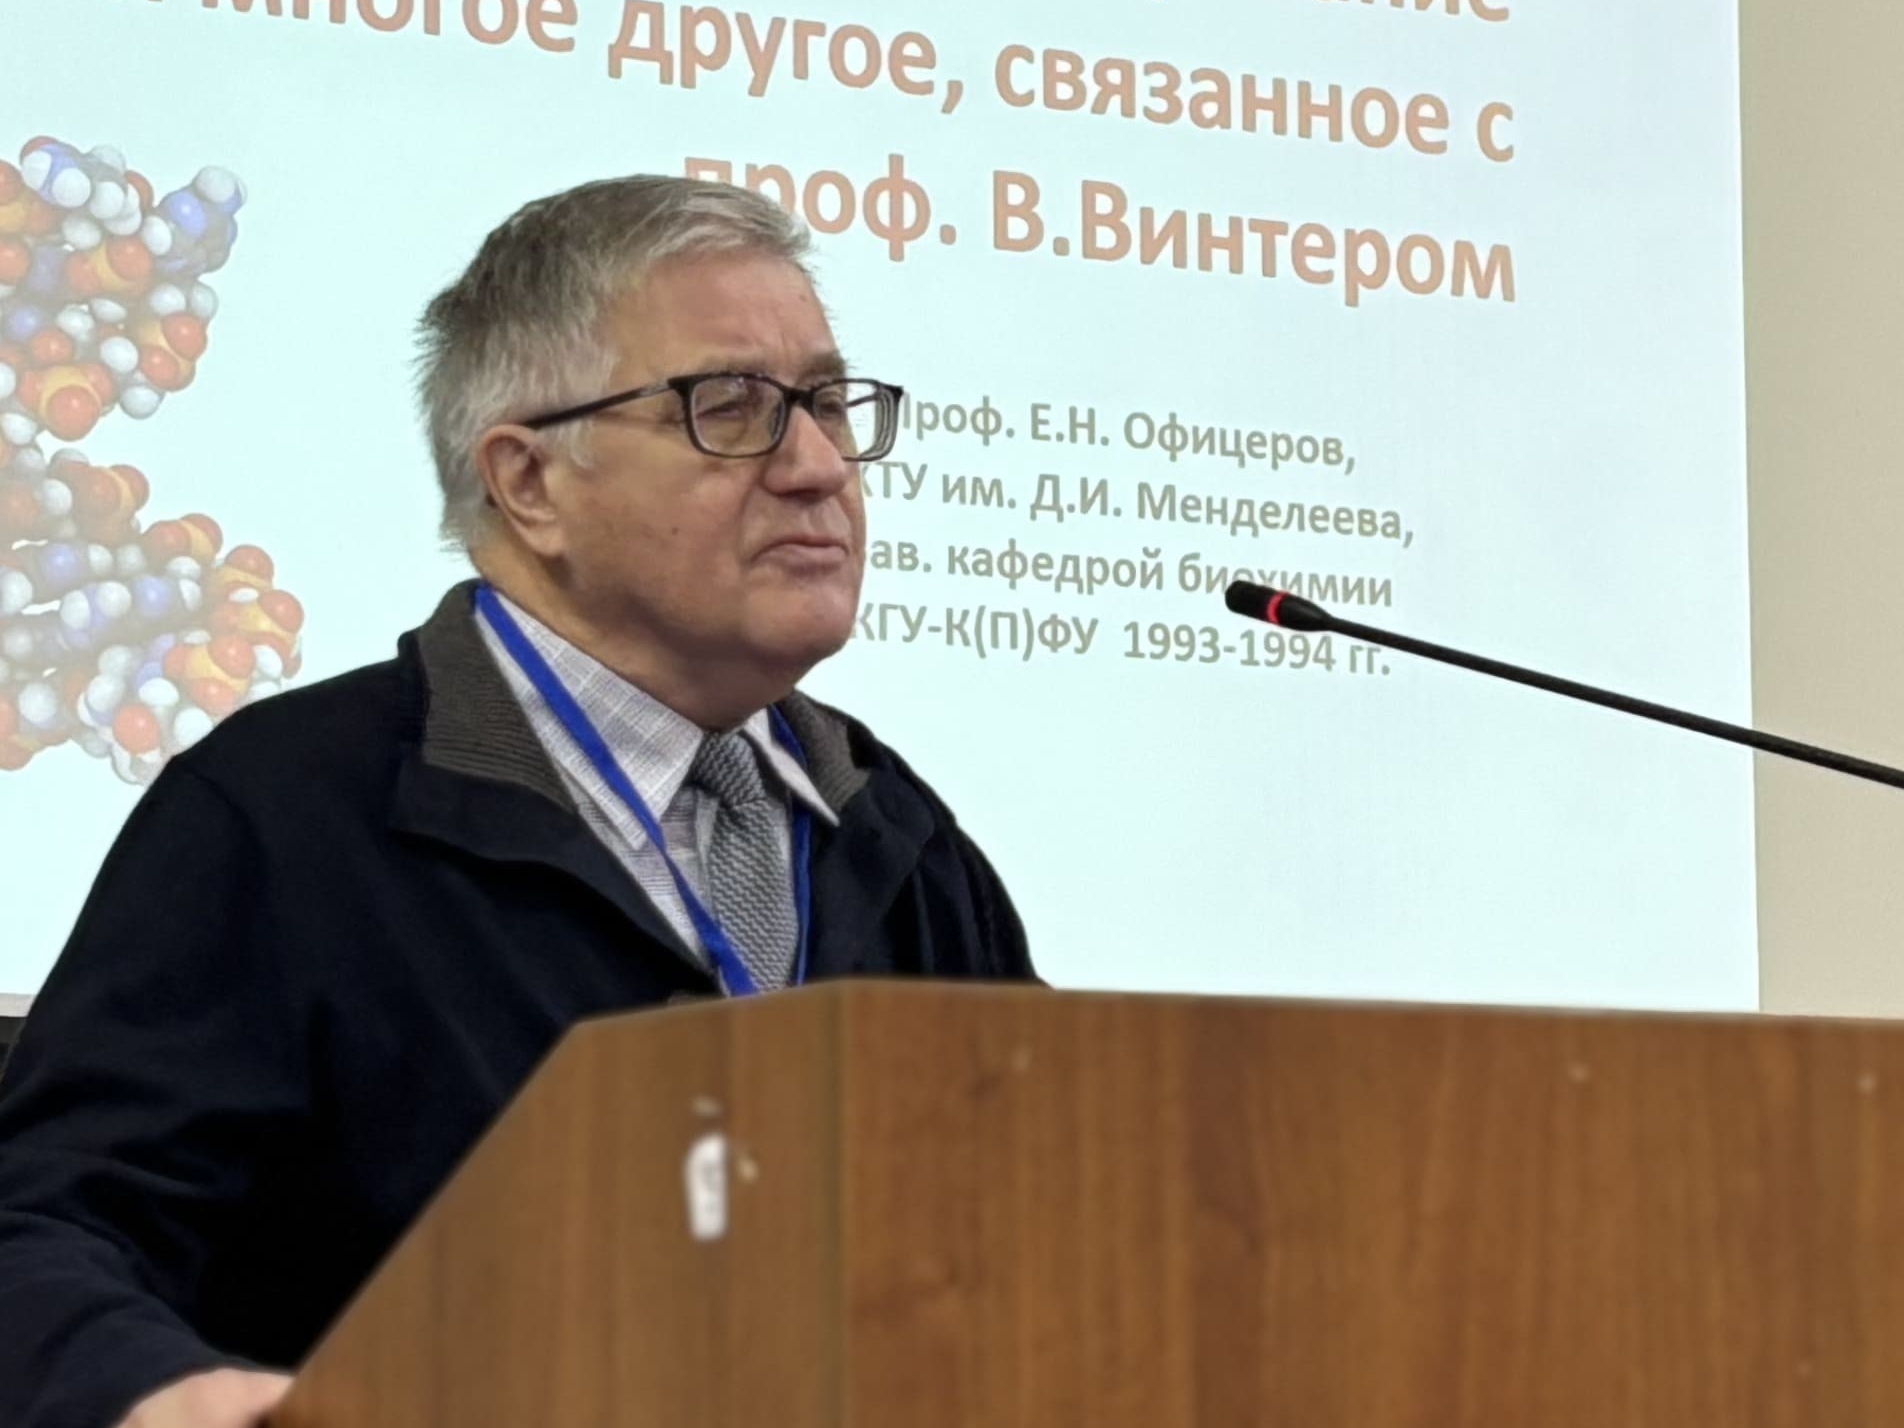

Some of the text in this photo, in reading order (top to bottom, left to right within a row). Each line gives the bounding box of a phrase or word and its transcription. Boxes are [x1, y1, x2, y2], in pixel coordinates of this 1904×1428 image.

[995, 44, 1449, 155] связанное
[1477, 102, 1514, 162] с
[993, 170, 1515, 308] В.Винтером
[1031, 403, 1109, 446] Е.Н.
[1124, 412, 1354, 475] Офицеров,
[943, 474, 1016, 509] им.
[1030, 474, 1121, 523] Д.И.
[1138, 482, 1413, 548] Менделеева,
[870, 540, 932, 572] ав.
[948, 538, 1163, 595] кафедрой
[1124, 621, 1336, 672] 1993-1994
[1350, 645, 1390, 675] гг.
